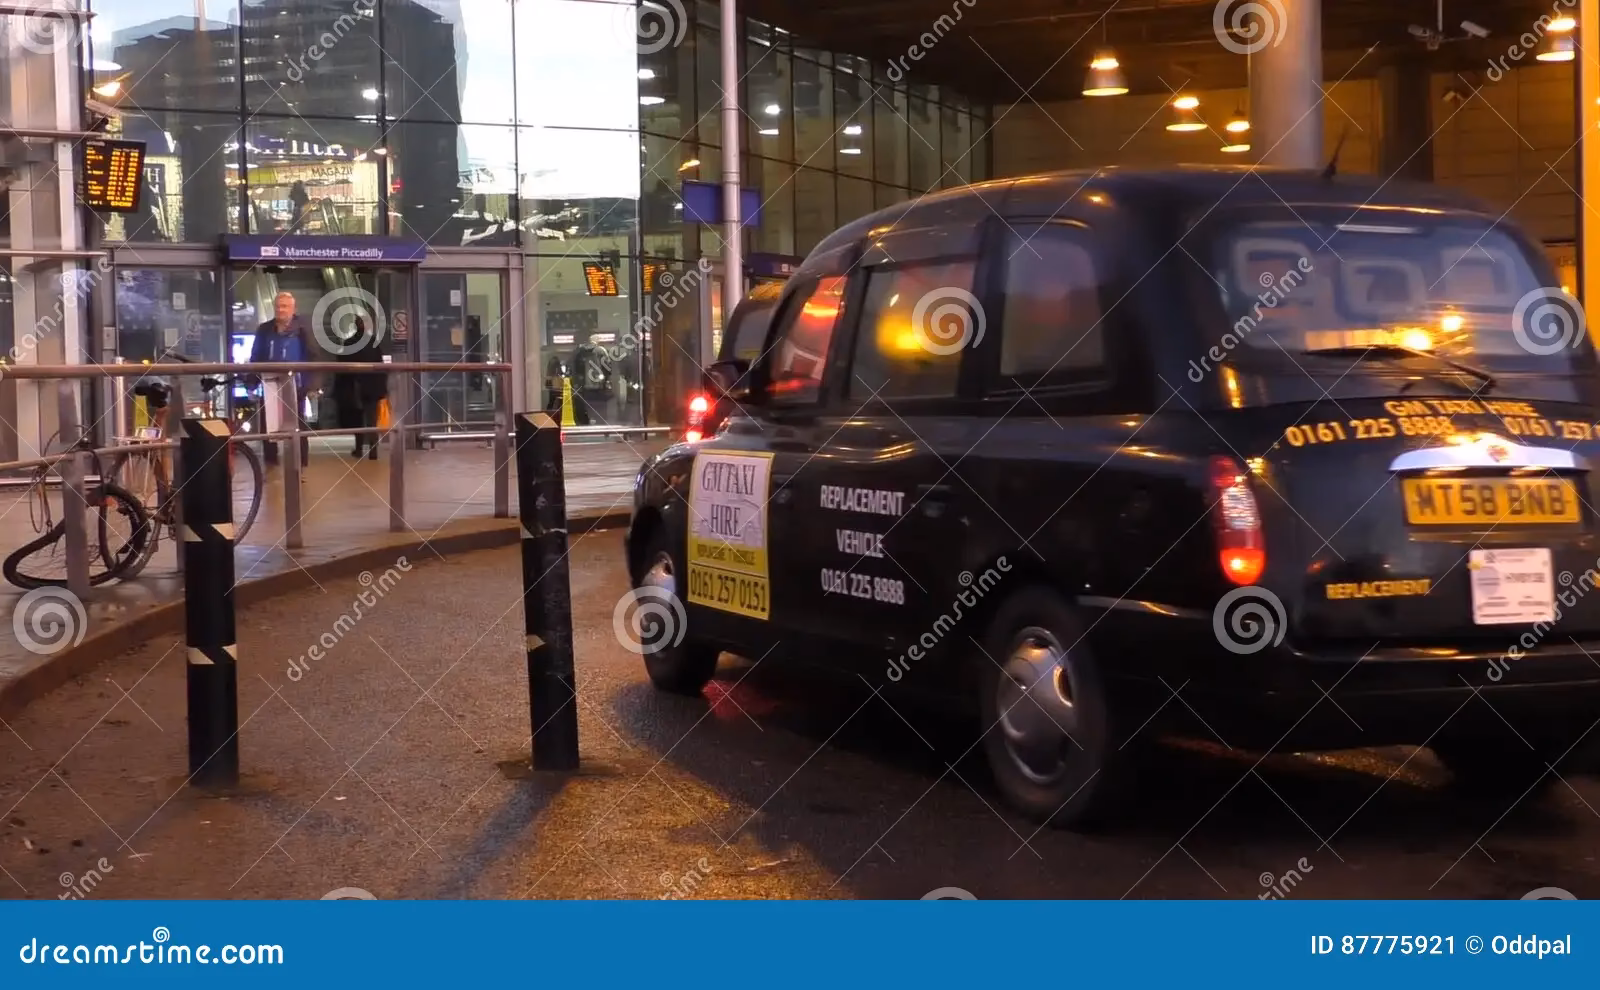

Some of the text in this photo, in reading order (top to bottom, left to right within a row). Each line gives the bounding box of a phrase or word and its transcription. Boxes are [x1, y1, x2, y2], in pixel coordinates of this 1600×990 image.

[285, 247, 384, 259] Manchester Piccadilly
[1384, 401, 1432, 415] GM
[1426, 400, 1485, 415] TAXI
[1286, 416, 1455, 447] 0161 225 8888
[1503, 416, 1557, 437] 0161
[1555, 420, 1593, 440] 257
[719, 463, 756, 496] TAXI
[820, 485, 904, 516] REPLACEMENT
[1416, 484, 1566, 516] MT58 BNB
[710, 503, 741, 538] HIRE
[836, 529, 884, 558] VEHICLE
[691, 568, 766, 612] 0161 257 0151
[821, 568, 905, 605] 0161 225 8888
